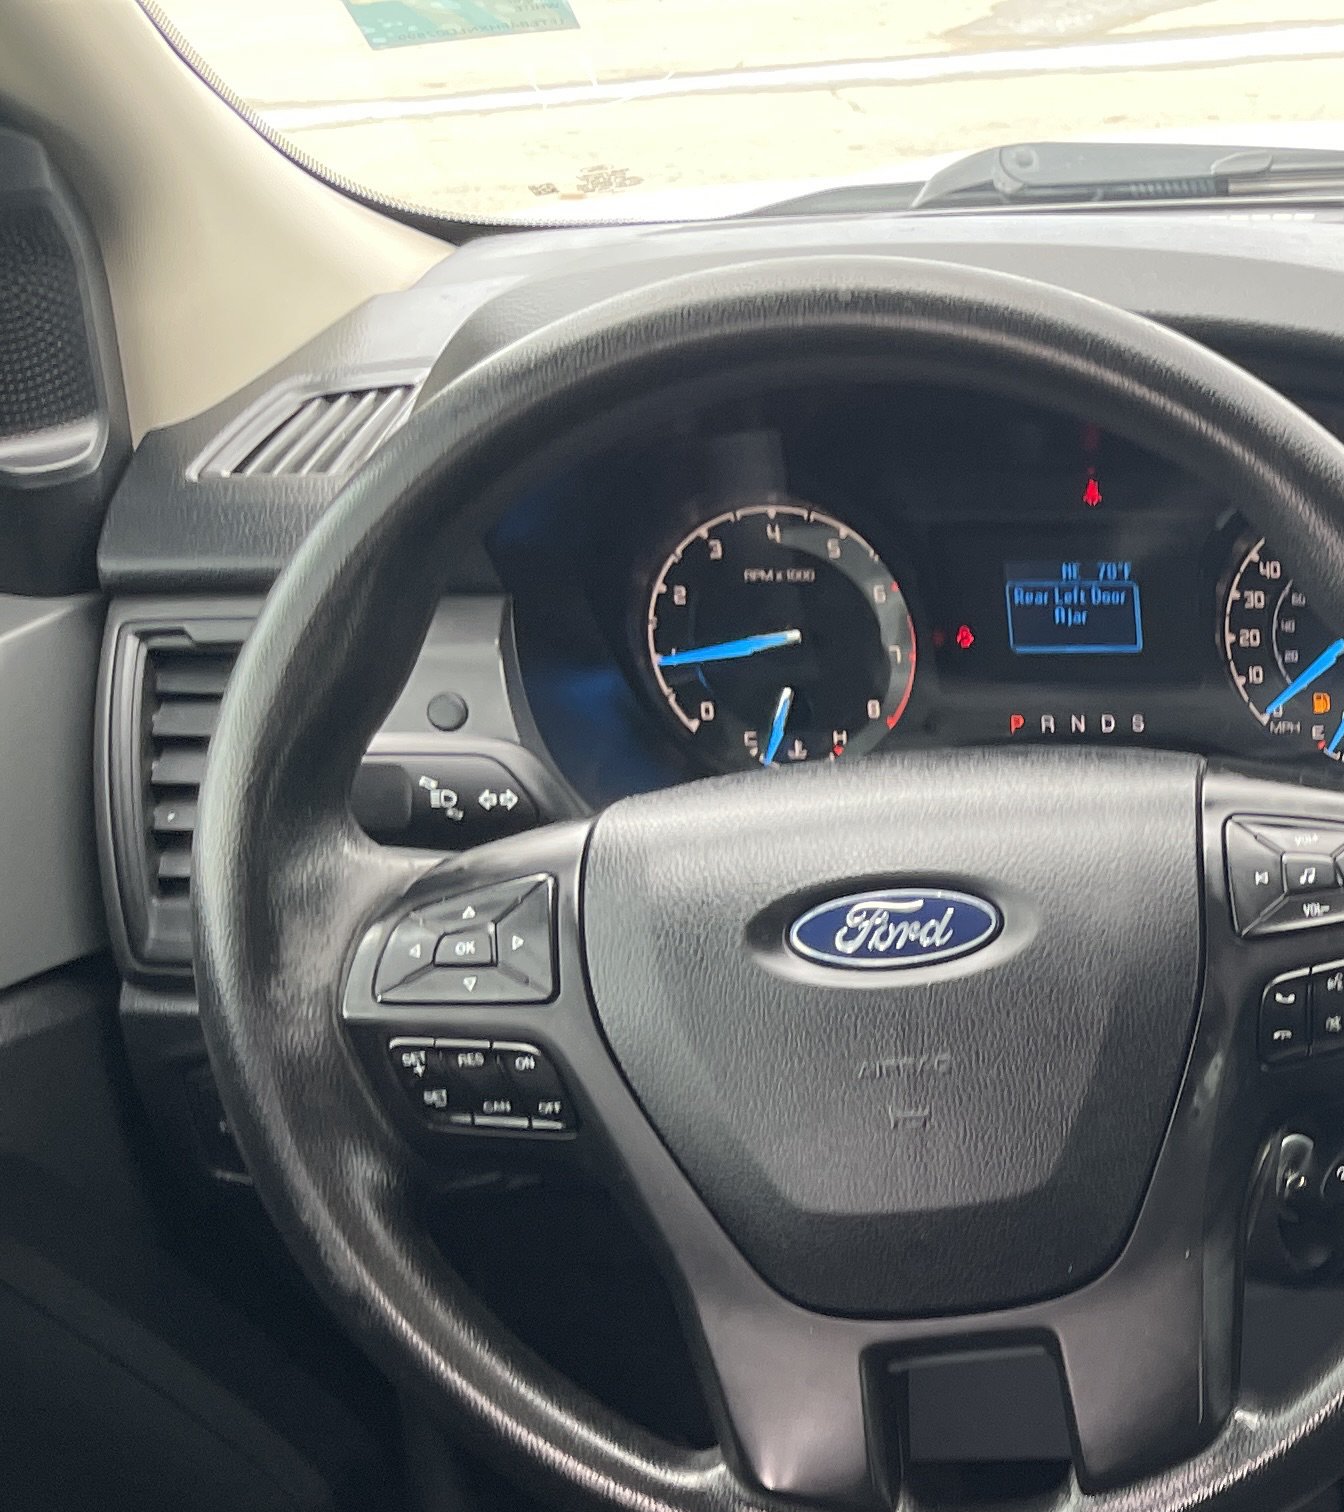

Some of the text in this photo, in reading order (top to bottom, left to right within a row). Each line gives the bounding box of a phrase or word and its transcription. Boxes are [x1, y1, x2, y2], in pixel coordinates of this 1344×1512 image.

[766, 523, 781, 544] 4
[708, 539, 723, 560] 3
[827, 538, 841, 560] 5
[743, 568, 773, 583] RPM
[786, 569, 816, 583] 1000
[1259, 560, 1281, 579] 40
[873, 584, 886, 604] 6
[1014, 583, 1126, 606] Rear Left Door
[1243, 590, 1266, 609] 30
[1054, 606, 1088, 627] Ajar
[1239, 628, 1261, 647] 20
[1248, 665, 1263, 684] 10
[700, 700, 715, 721] 0
[1009, 714, 1025, 735] P
[1041, 714, 1055, 734] R
[1071, 714, 1086, 734] N
[1101, 714, 1115, 734] D
[1269, 720, 1301, 735] MPH
[834, 898, 955, 954] Ford
[454, 940, 476, 956] OK
[457, 1052, 485, 1069] RES
[515, 1056, 536, 1071] ON
